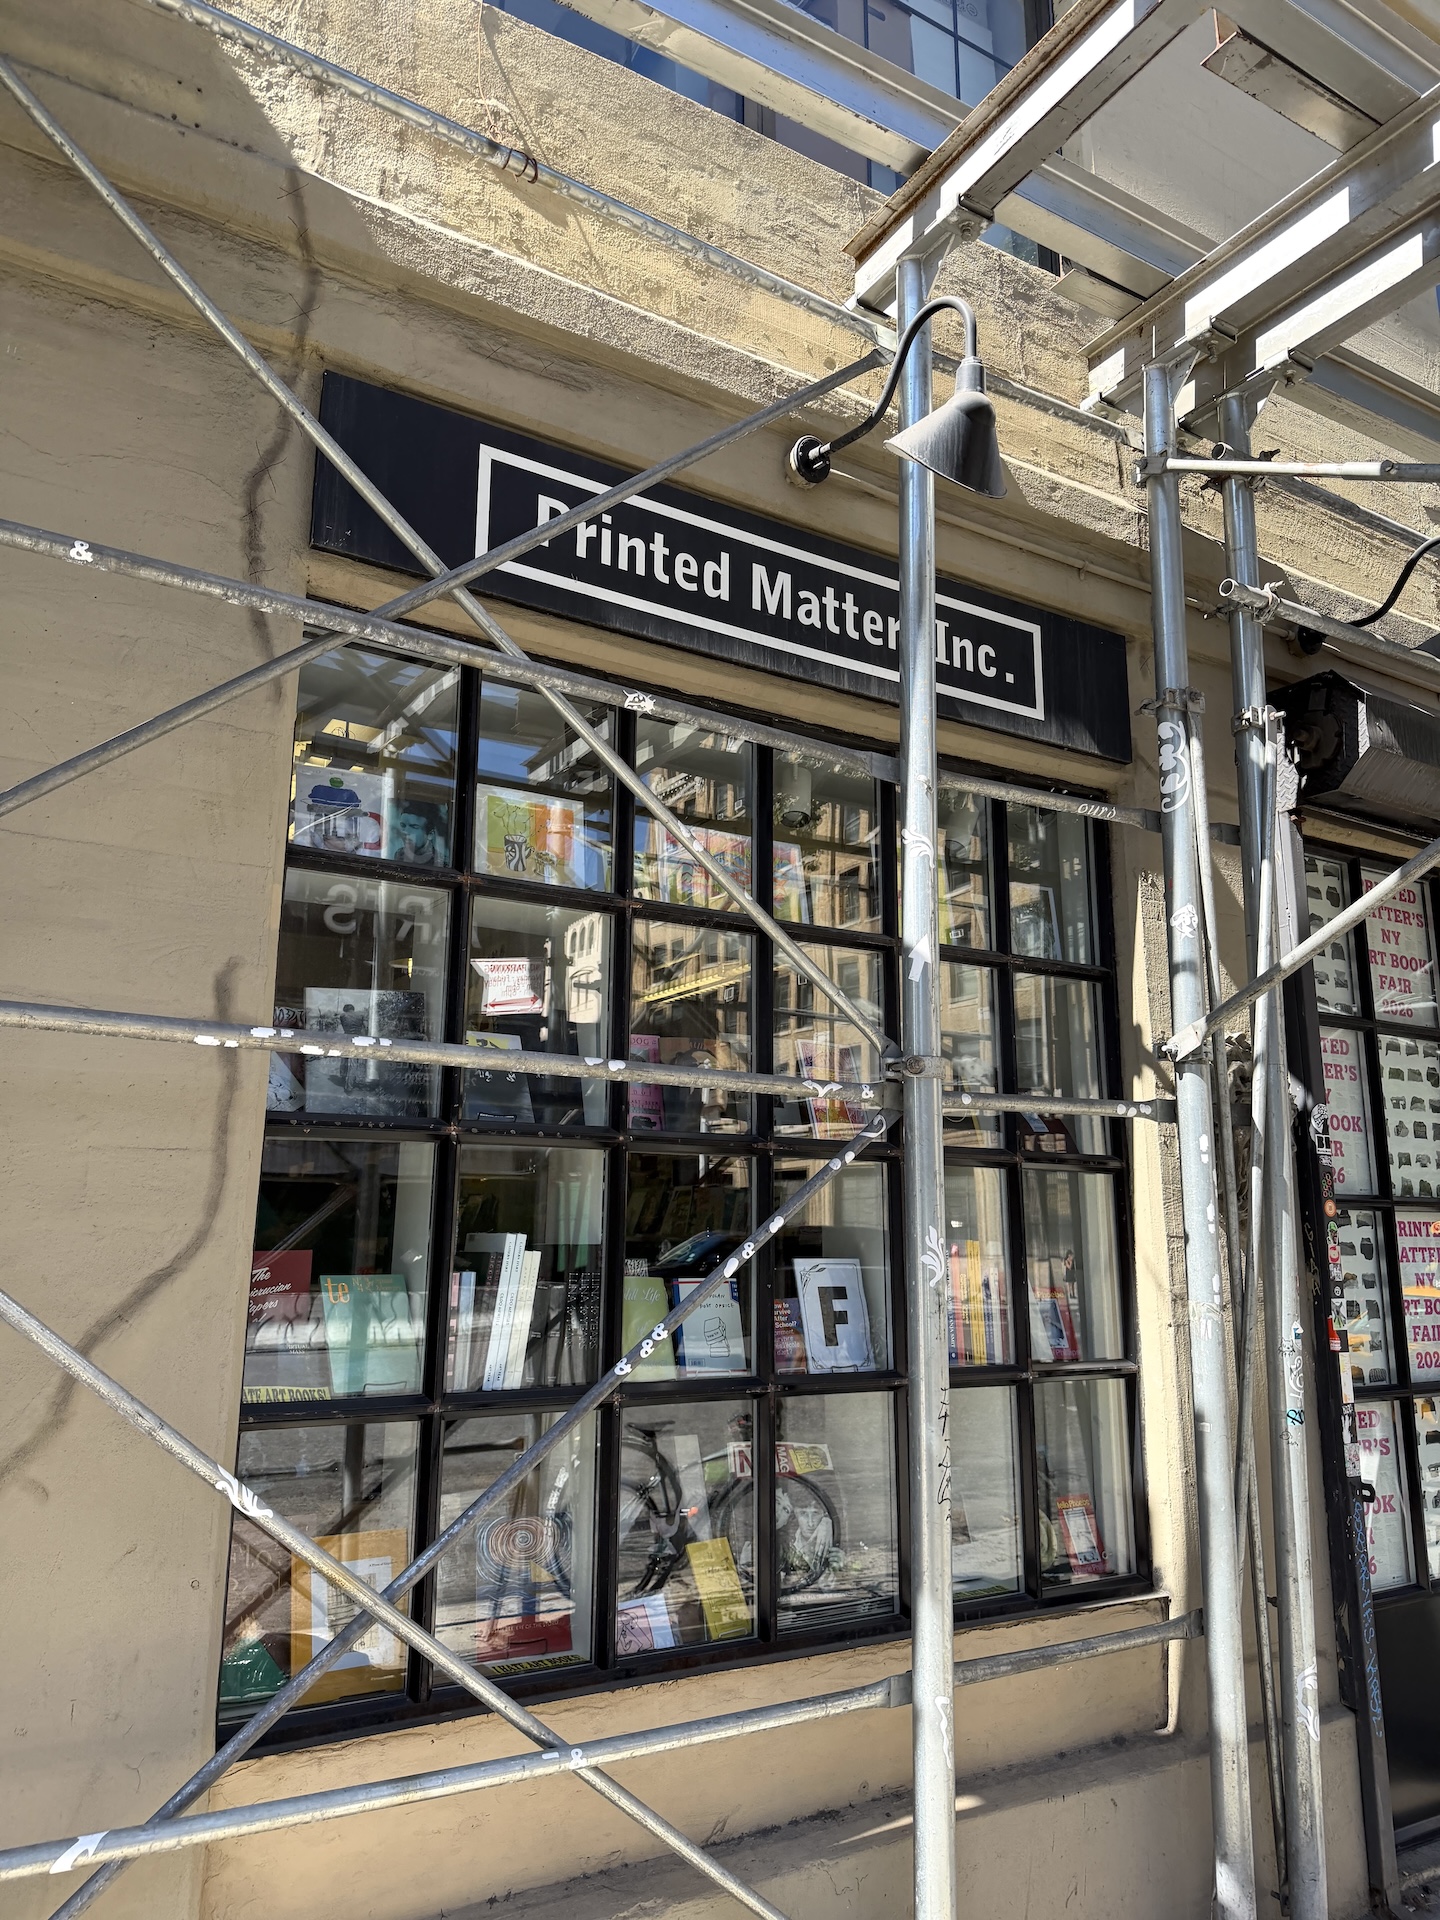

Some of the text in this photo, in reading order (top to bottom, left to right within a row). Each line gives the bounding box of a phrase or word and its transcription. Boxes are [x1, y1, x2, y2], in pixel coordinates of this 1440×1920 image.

[934, 619, 1015, 684] Inc.
[1077, 803, 1117, 819] ours
[1381, 928, 1402, 946] NY
[1389, 953, 1429, 975] BOOK
[1379, 974, 1412, 994] FAIR
[1382, 999, 1413, 1018] 2026
[1330, 1115, 1363, 1132] OOK
[252, 1267, 272, 1283] The
[325, 1278, 350, 1304] te
[643, 1287, 661, 1305] Life
[775, 1321, 798, 1329] School?
[818, 1286, 849, 1347] F
[1412, 1325, 1440, 1342] FAI
[265, 1388, 286, 1403] ART
[287, 1388, 327, 1402] BOOKS!
[1355, 1410, 1381, 1429] ED
[1358, 1437, 1391, 1456] R'S
[776, 1446, 790, 1473] MAG
